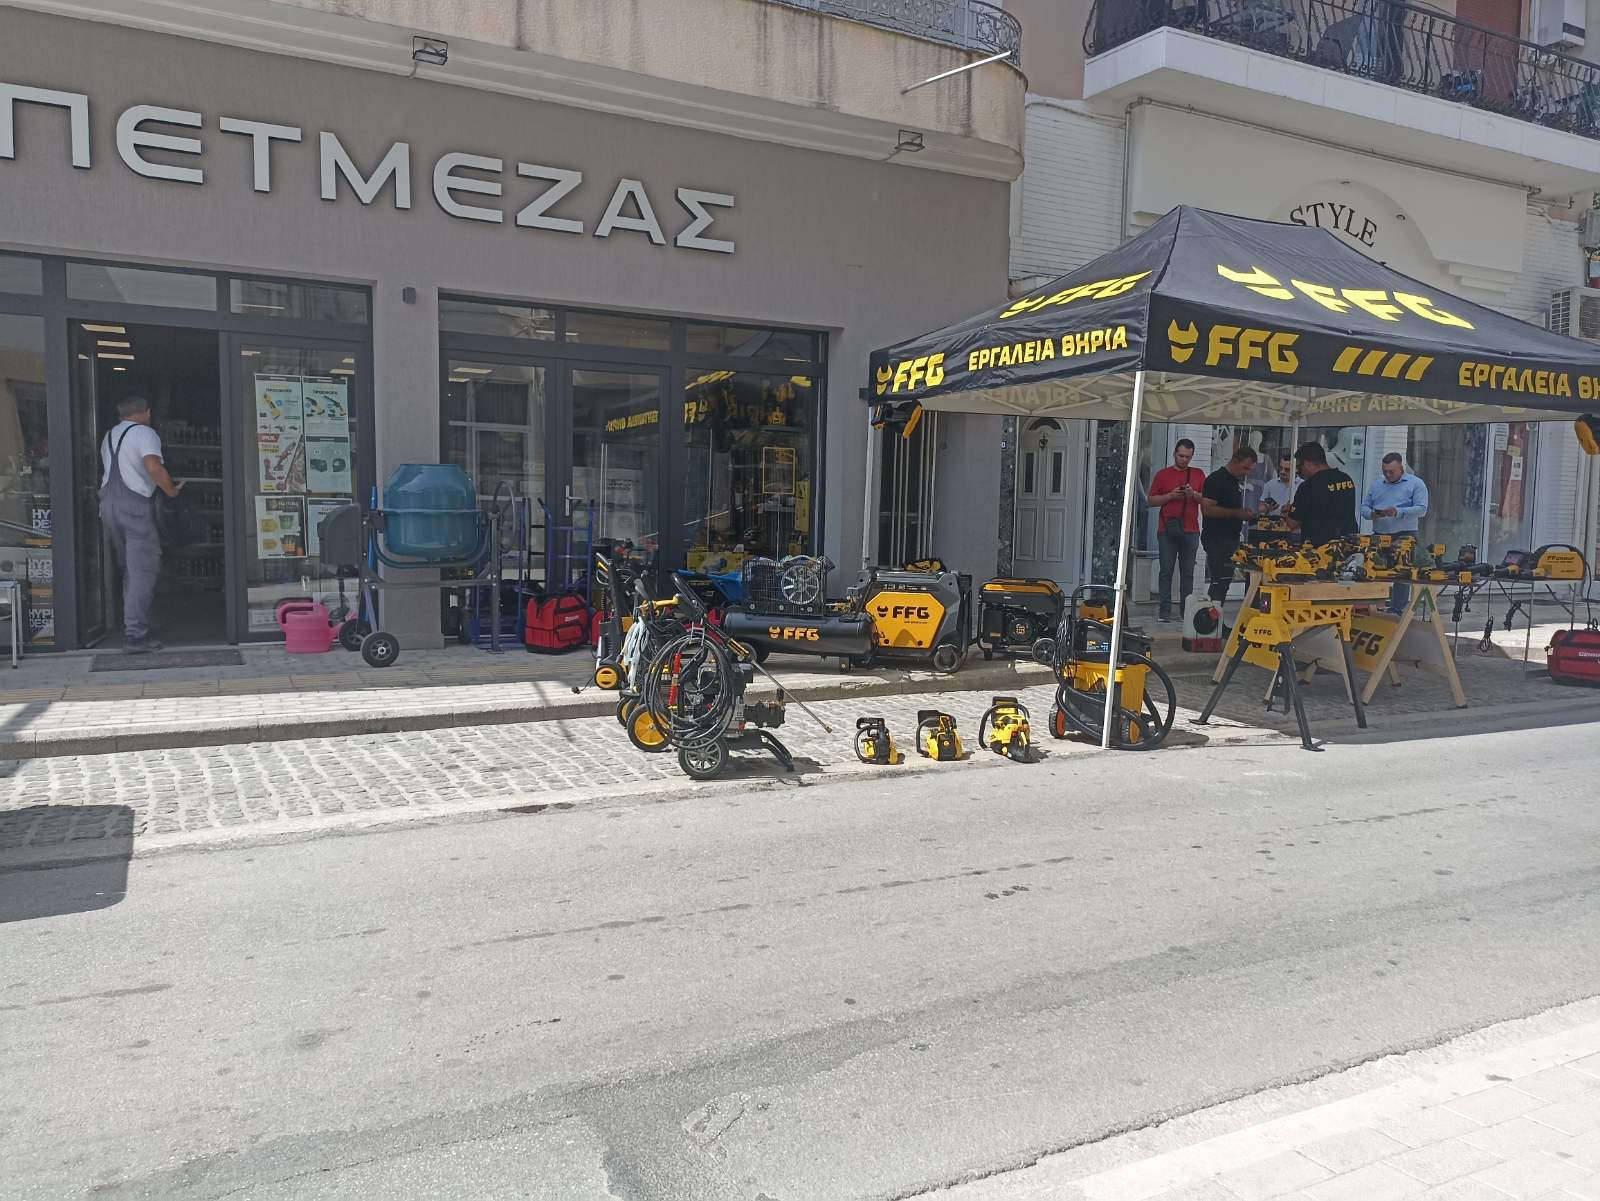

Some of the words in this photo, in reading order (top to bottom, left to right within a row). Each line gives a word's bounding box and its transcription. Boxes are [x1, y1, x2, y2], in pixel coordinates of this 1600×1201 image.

[0, 82, 735, 254] ΠΕΤΜΕΖΑΣ
[1290, 202, 1378, 248] STYLE
[1290, 279, 1476, 330] FFG
[891, 353, 946, 393] FFG
[968, 338, 1055, 371] ΕΡΓΑΛΕΙΑ
[1061, 325, 1128, 357] ΘΗΡΙΑ
[1205, 324, 1300, 374] FFG
[1458, 361, 1572, 397] ΕΡΓΑΛΕΙΑ
[1335, 480, 1354, 491] FFG
[32, 519, 52, 529] DE
[783, 626, 821, 641] FFG
[892, 605, 930, 619] FFG
